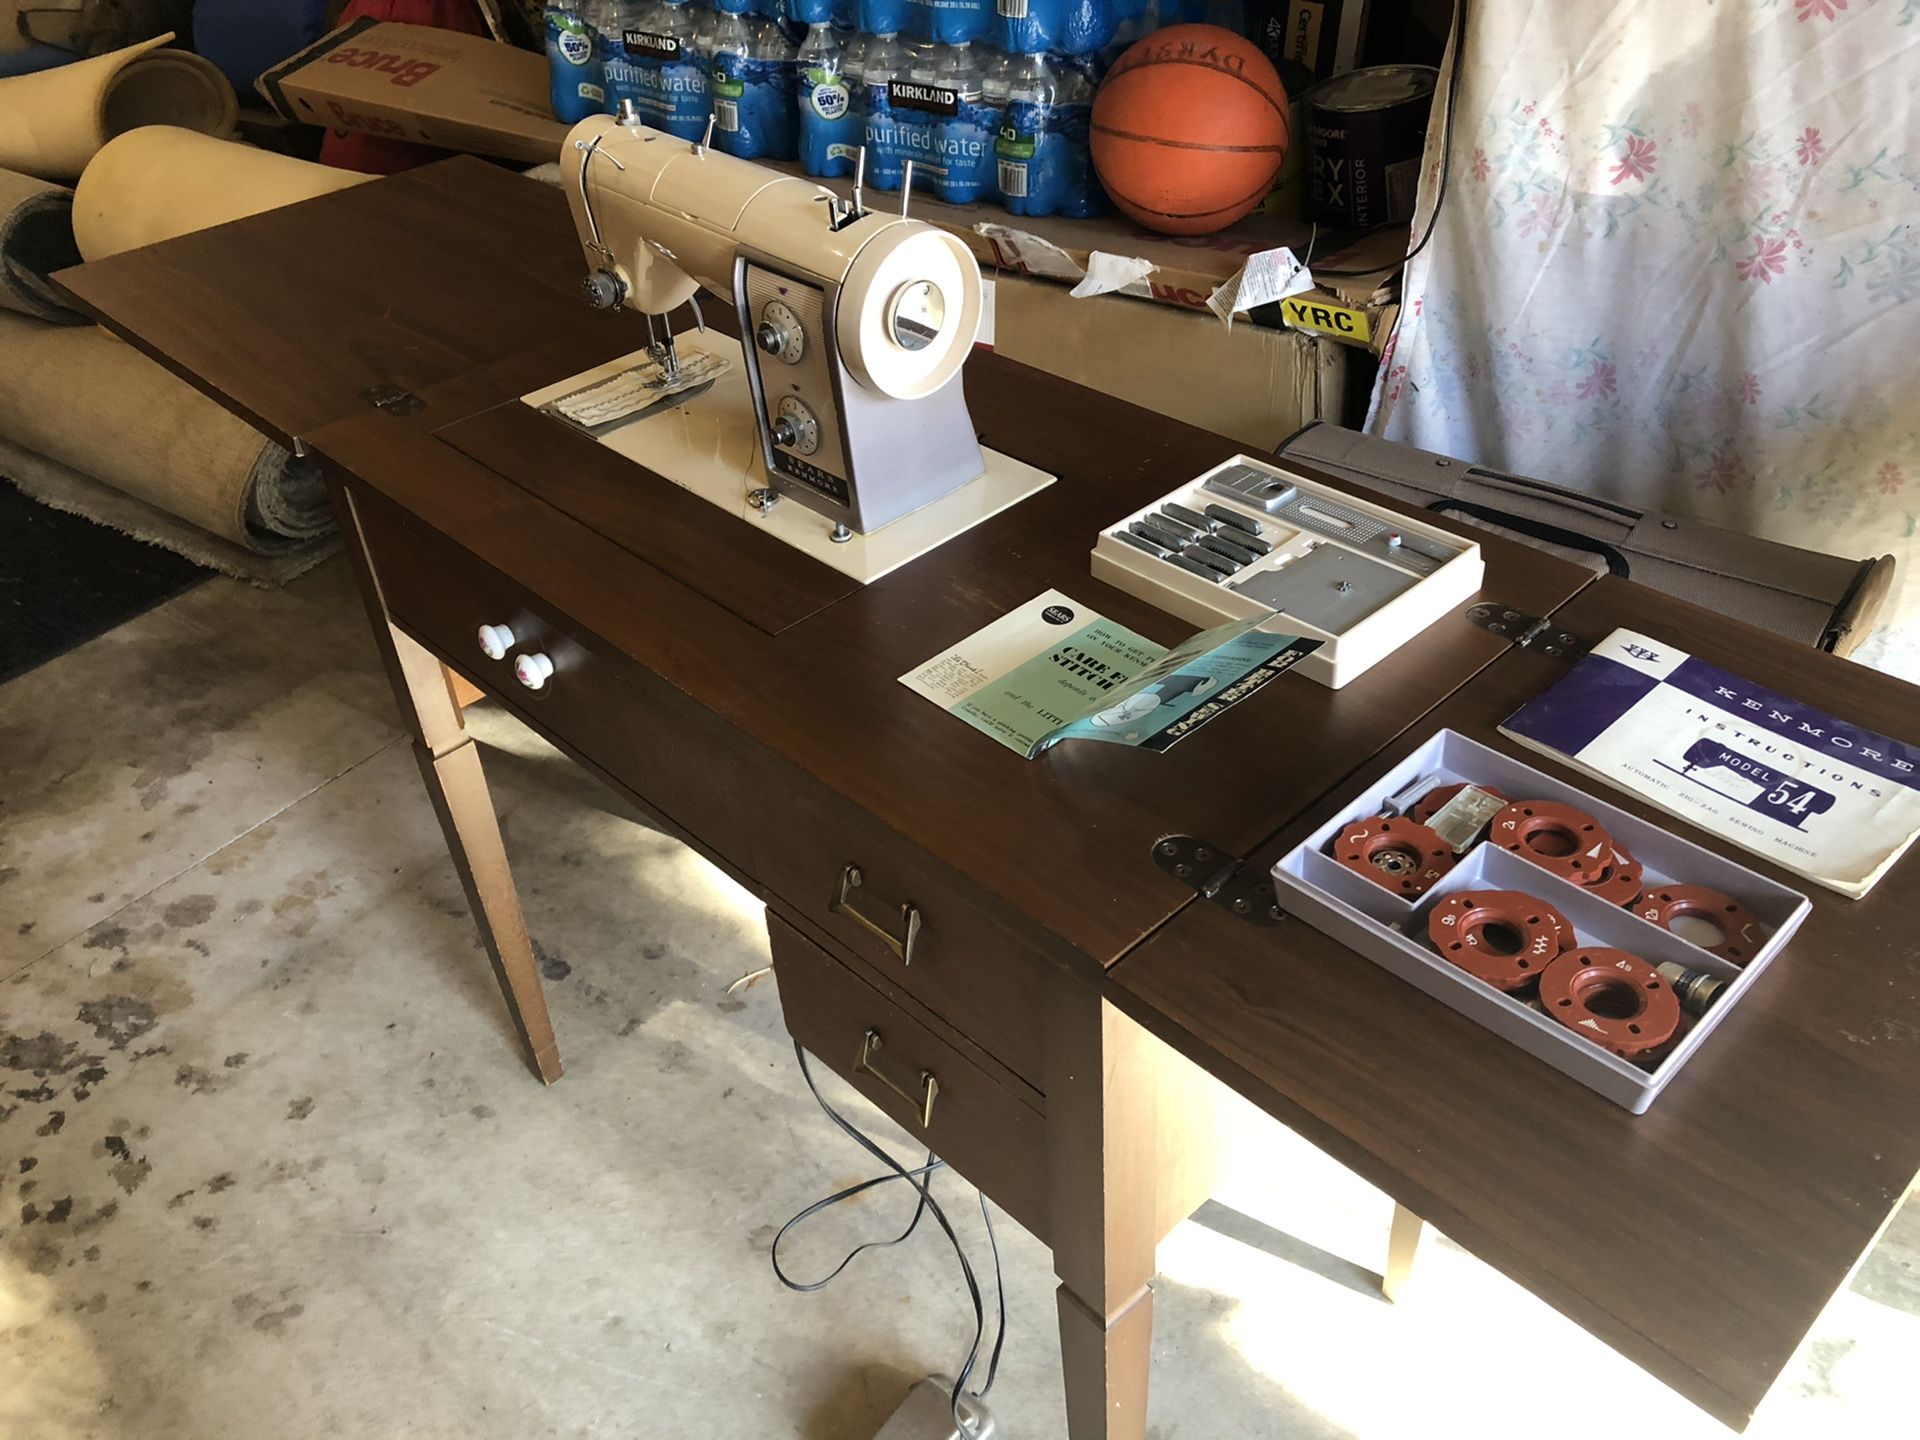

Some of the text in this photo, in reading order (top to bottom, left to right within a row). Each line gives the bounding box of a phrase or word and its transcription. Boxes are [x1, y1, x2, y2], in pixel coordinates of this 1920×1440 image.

[564, 40, 588, 53] 50%
[625, 32, 677, 52] KIRKLAND
[328, 47, 442, 88] Bruce
[604, 65, 658, 87] purified
[660, 76, 708, 94] water
[817, 93, 845, 106] 50%
[892, 83, 955, 105] KIRKLAND
[866, 124, 930, 149] purified
[935, 134, 988, 157] water
[1354, 158, 1369, 226] INTERIOR
[1288, 301, 1354, 333] YRC
[1047, 606, 1071, 622] SEARS
[1086, 633, 1097, 641] ON
[1101, 640, 1122, 653] YOUR
[1094, 628, 1111, 640] HOW
[1128, 647, 1144, 656] GET
[1048, 653, 1114, 691] STITCH
[1062, 645, 1111, 674] CARE
[1004, 690, 1021, 701] and
[1021, 699, 1034, 709] the
[1713, 685, 1915, 773] KENMORE
[1684, 707, 1883, 799] INSTRUCTIONS
[1718, 751, 1770, 783] MODEL
[1766, 779, 1817, 816] 54
[1621, 762, 1819, 859] AUTOMATIC ZIG-ZAG SEWING MACHINE
